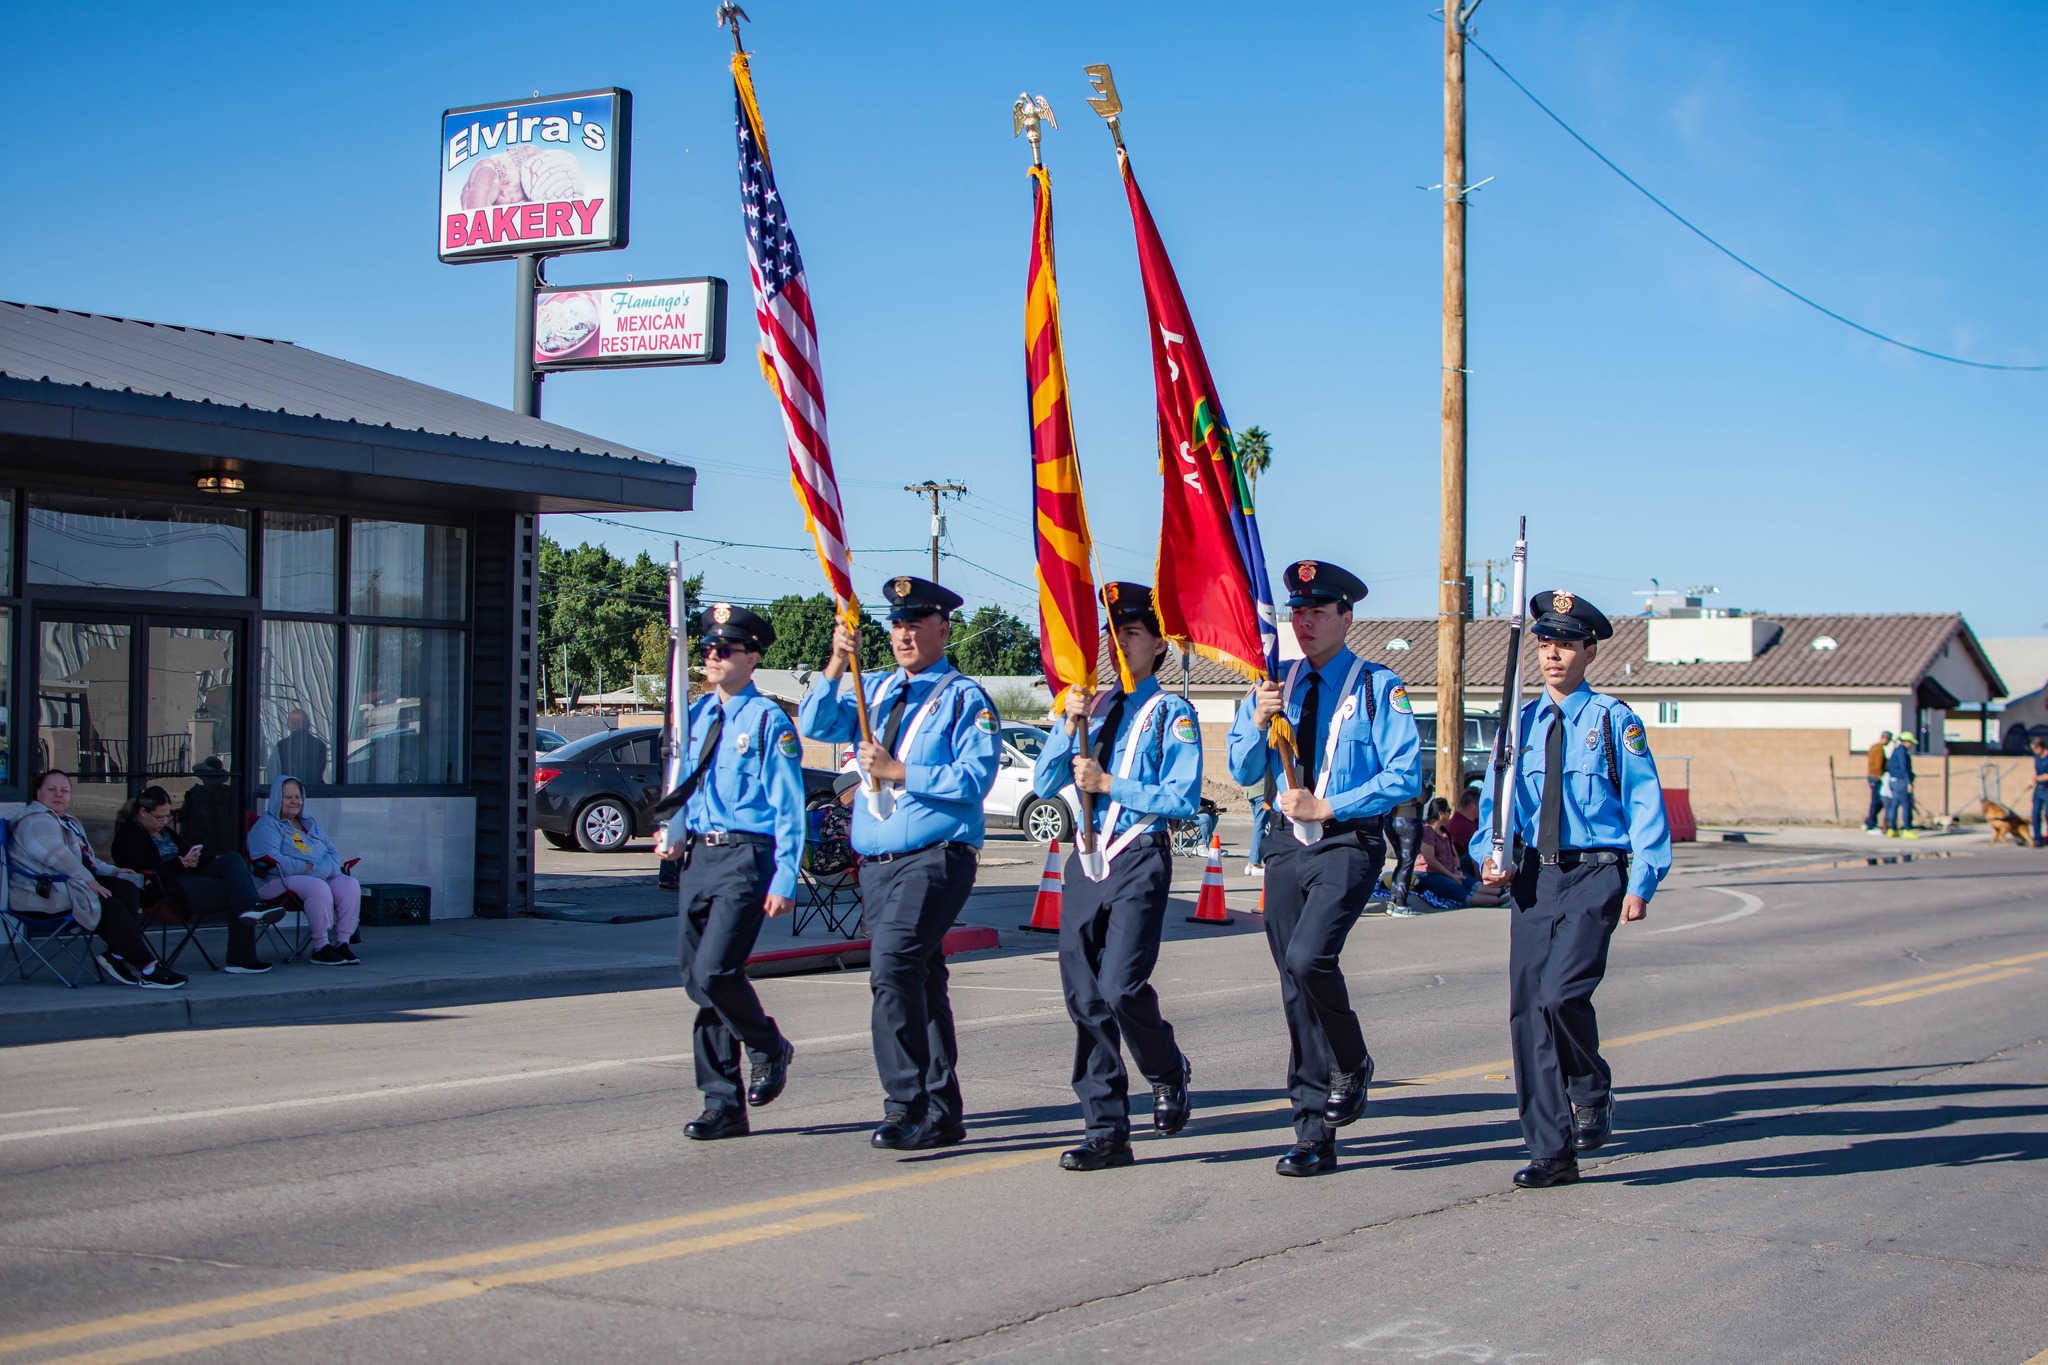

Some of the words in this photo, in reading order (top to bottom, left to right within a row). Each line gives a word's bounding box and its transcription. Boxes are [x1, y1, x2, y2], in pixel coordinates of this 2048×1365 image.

[448, 110, 606, 171] Elvira's
[446, 199, 604, 249] BAKERY
[610, 290, 690, 315] Flamingo's
[616, 314, 686, 333] MEXICAN
[600, 333, 703, 353] RESTAURANT
